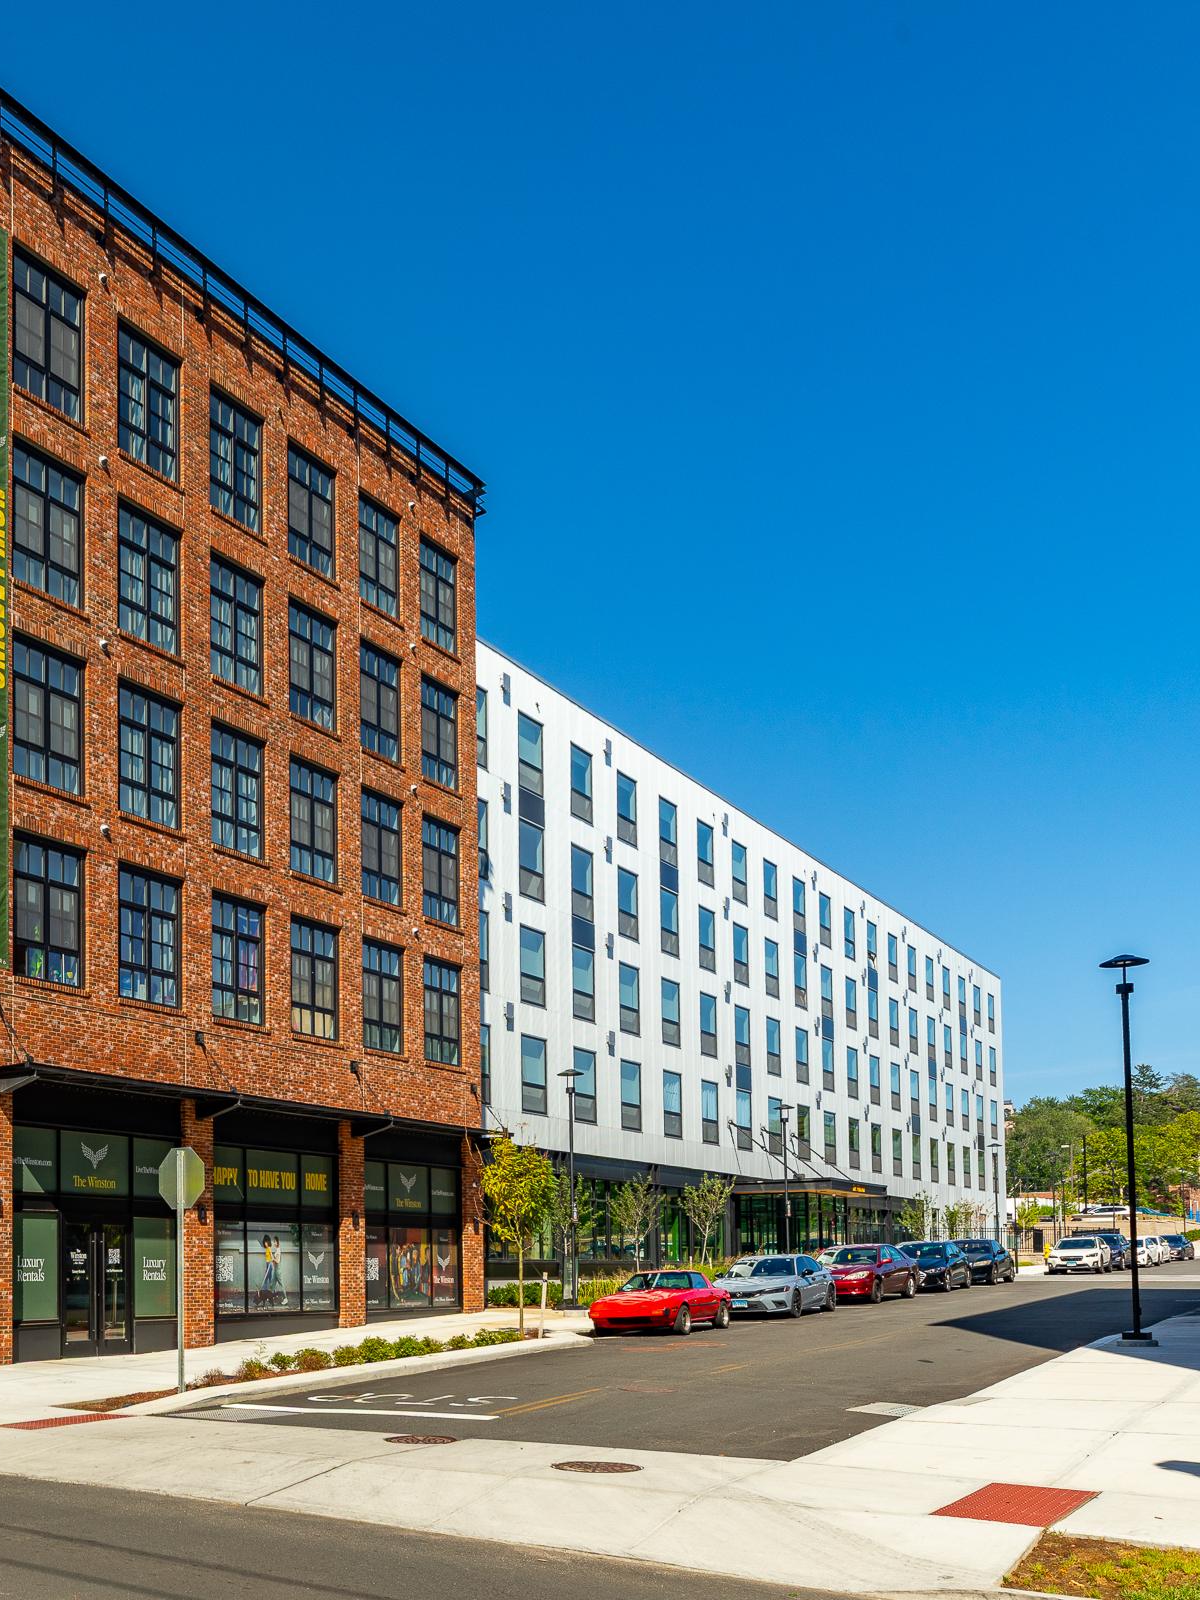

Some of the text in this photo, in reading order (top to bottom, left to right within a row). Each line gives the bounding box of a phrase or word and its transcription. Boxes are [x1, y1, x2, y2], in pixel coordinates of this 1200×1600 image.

[73, 1176, 116, 1189] The Winston
[247, 1169, 258, 1187] TO
[259, 1170, 280, 1188] HAVE
[280, 1172, 296, 1190] YOU
[305, 1173, 327, 1191] HOME
[17, 1256, 45, 1270] Luxury
[143, 1257, 166, 1270] Luxury
[17, 1269, 45, 1282] Rentals
[143, 1269, 166, 1281] Rentals
